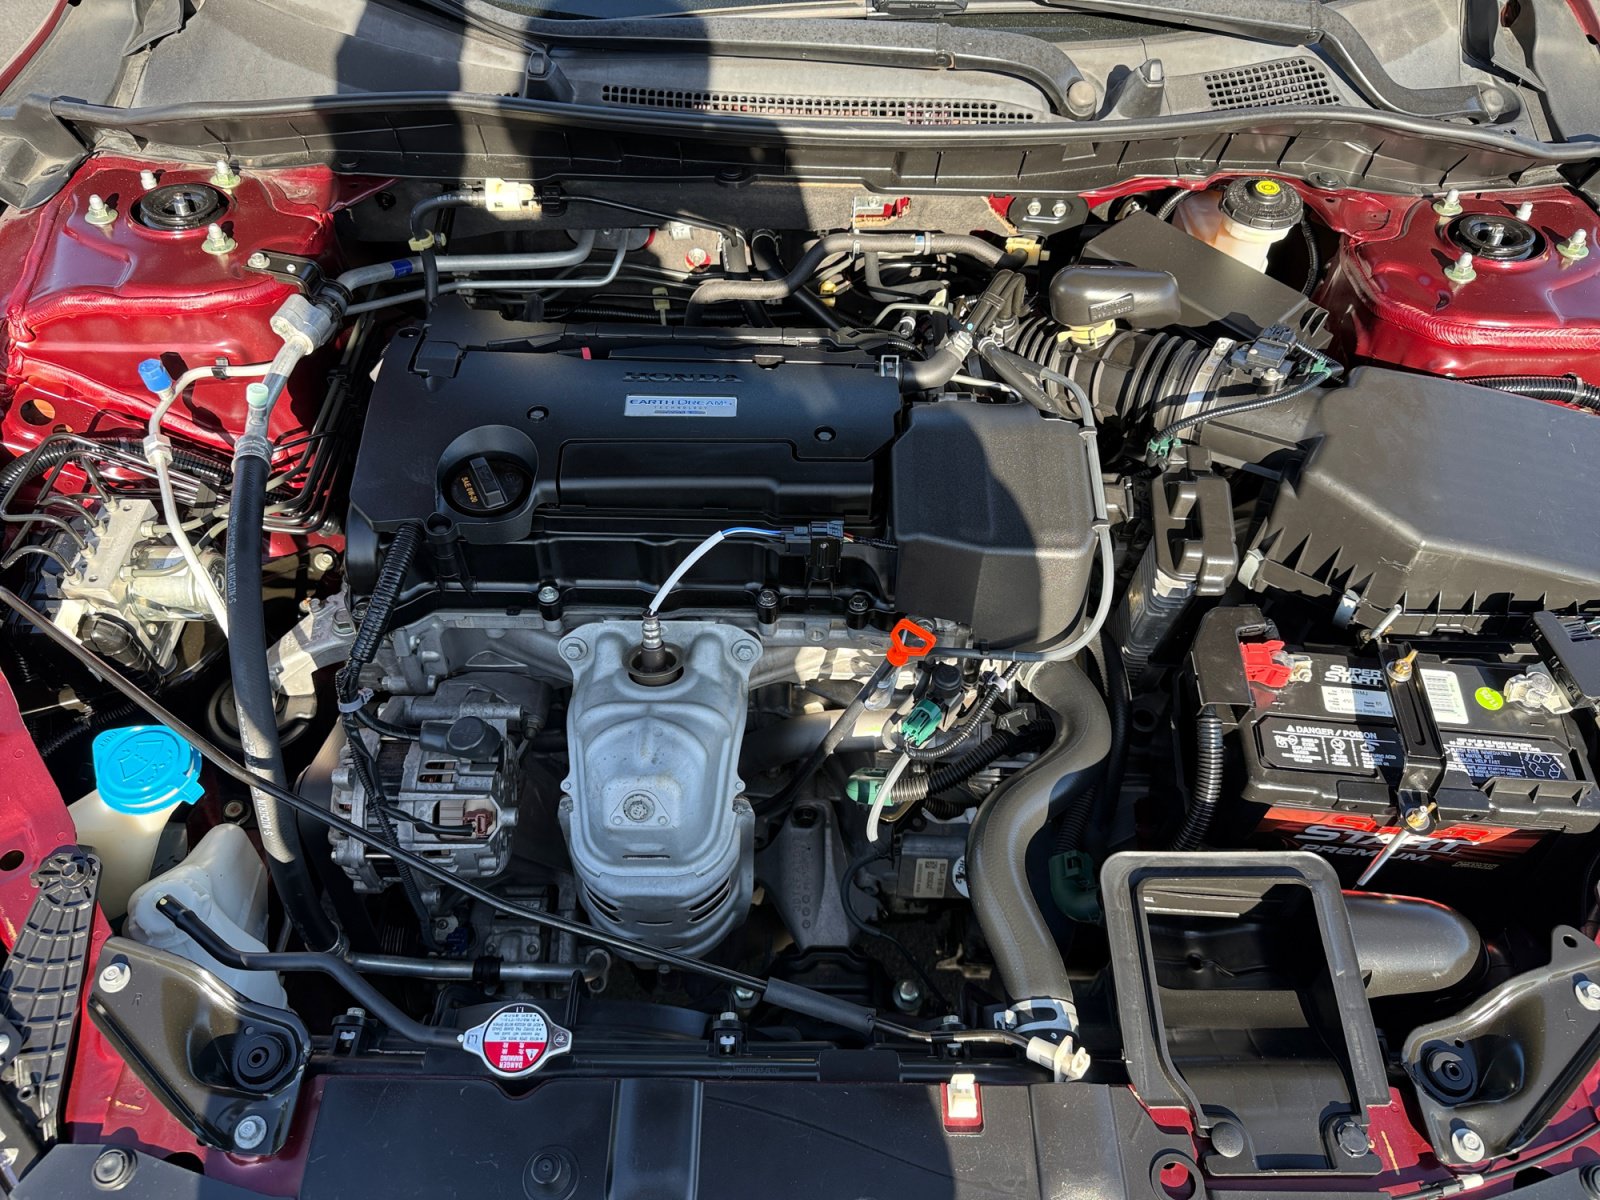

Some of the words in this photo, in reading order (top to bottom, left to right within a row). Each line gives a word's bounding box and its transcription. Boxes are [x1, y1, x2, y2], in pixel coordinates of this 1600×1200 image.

[622, 371, 743, 383] HONDA
[1329, 664, 1382, 678] SUPER
[1324, 671, 1383, 686] START
[1296, 726, 1334, 735] DANGER
[1343, 730, 1377, 739] POISON
[1295, 825, 1481, 855] START
[1300, 843, 1431, 862] PREMUM
